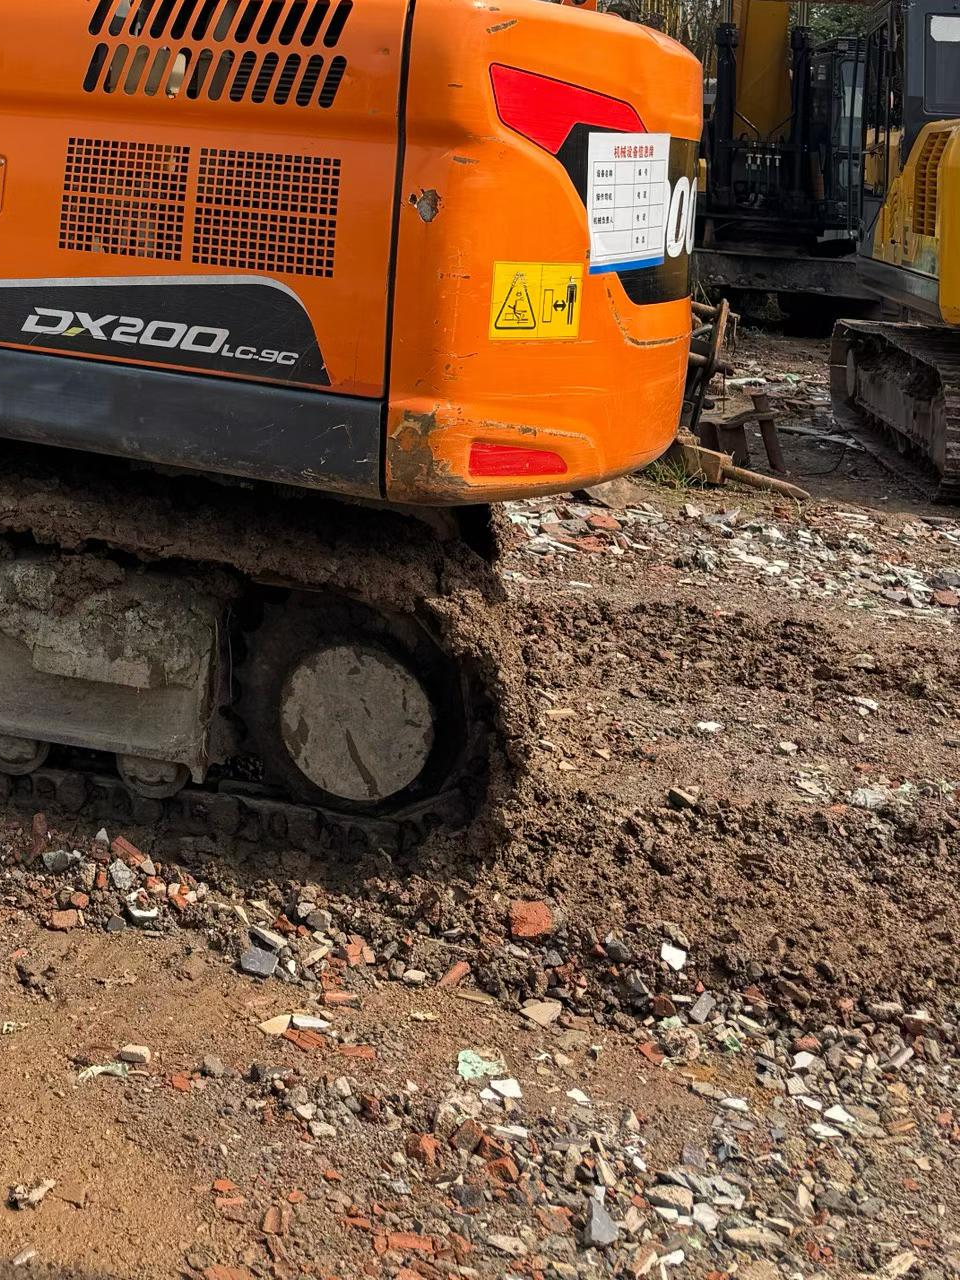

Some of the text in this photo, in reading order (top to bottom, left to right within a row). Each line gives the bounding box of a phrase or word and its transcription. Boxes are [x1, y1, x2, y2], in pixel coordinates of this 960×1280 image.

[613, 145, 655, 159] 机械设备信息牌
[665, 176, 698, 258] 00
